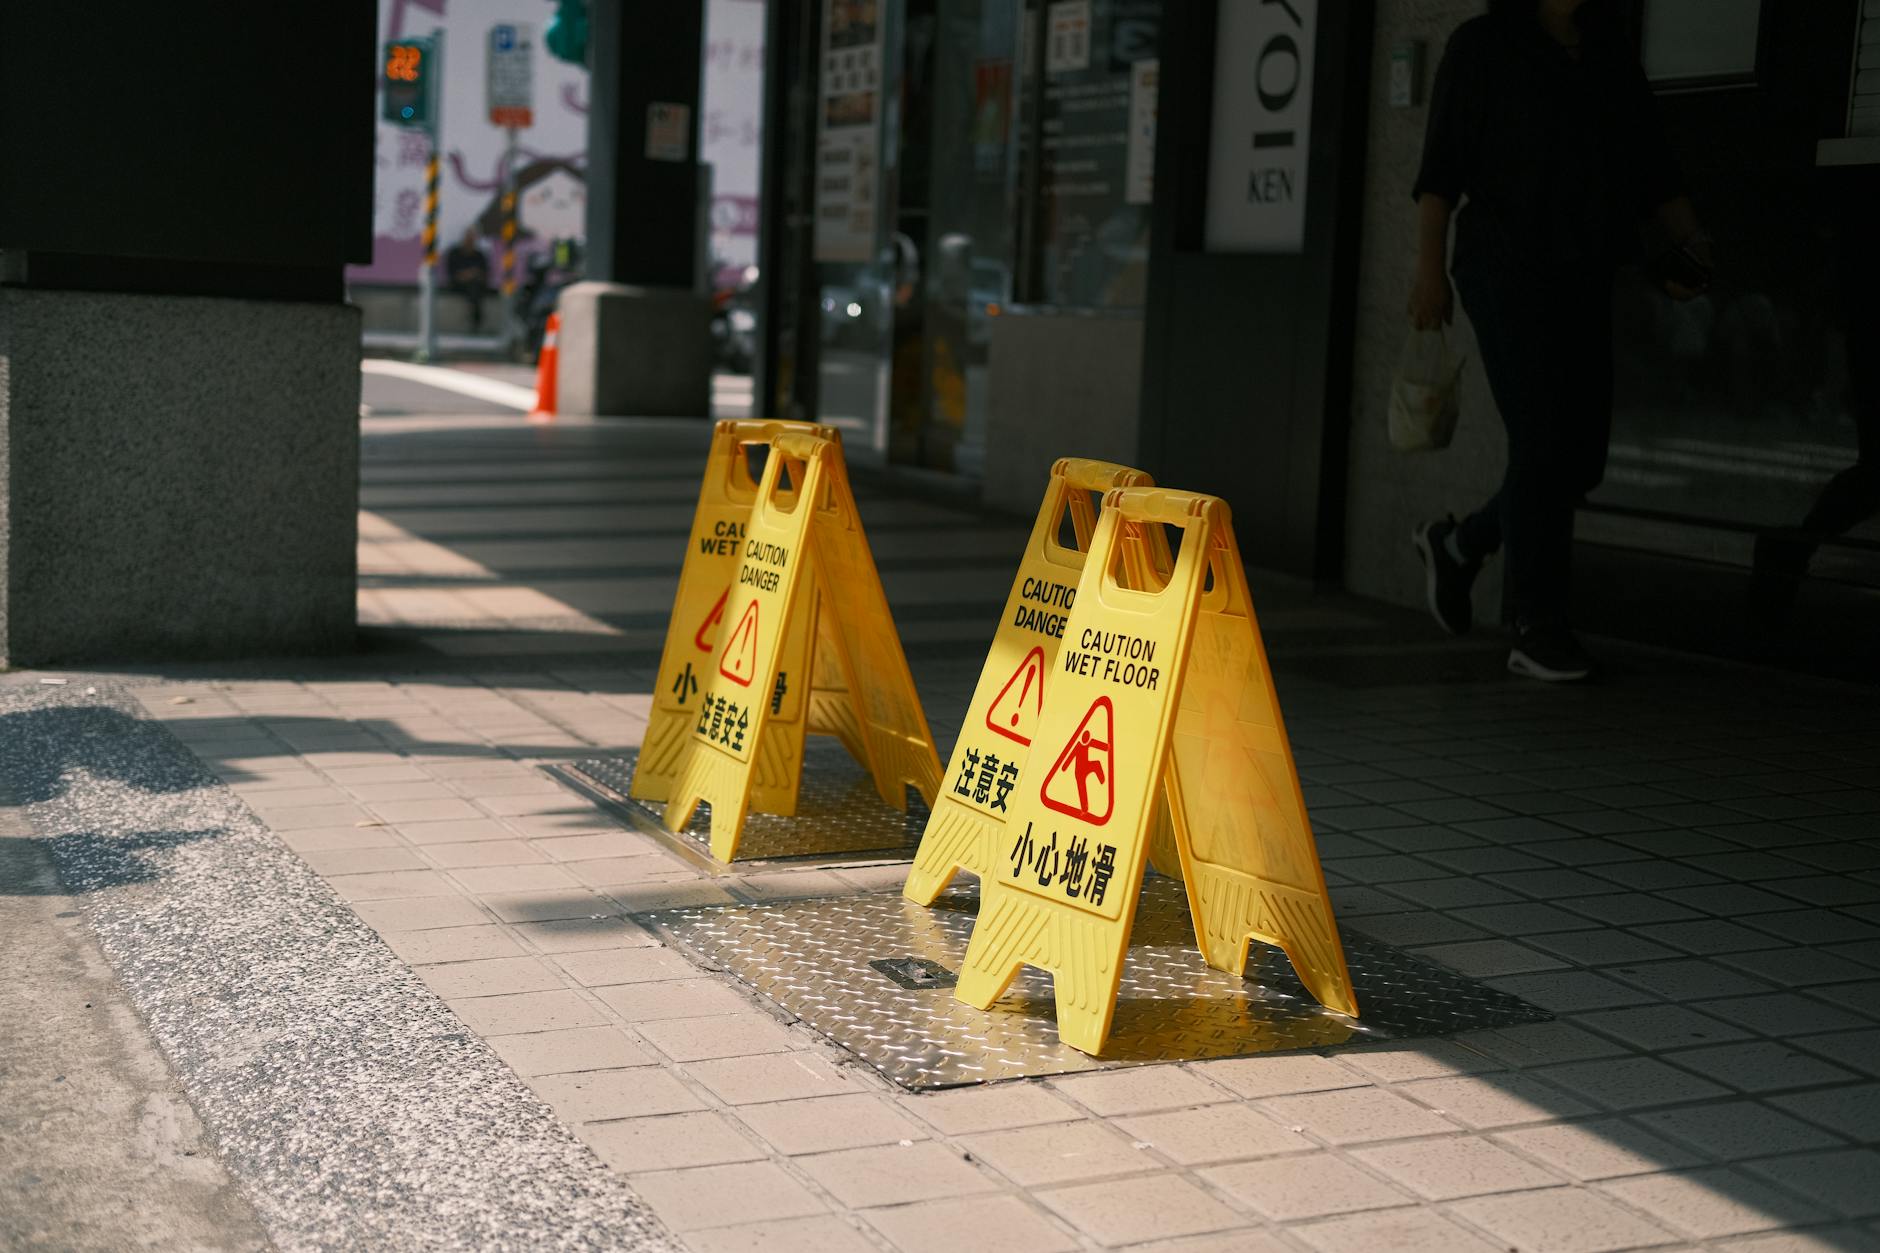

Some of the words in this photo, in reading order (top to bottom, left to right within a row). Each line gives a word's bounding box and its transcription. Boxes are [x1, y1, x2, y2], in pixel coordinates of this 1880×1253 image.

[1248, 168, 1296, 203] KEN
[701, 538, 740, 556] WET
[746, 539, 789, 567] CAUTION
[740, 564, 780, 593] DANGER
[1022, 577, 1077, 610] CAUTIO
[1014, 605, 1069, 639] DANGE
[1081, 628, 1156, 662] CAUTION
[1064, 651, 1102, 678] WET
[1103, 659, 1160, 690] FLOOR
[696, 691, 749, 752] 注意安全
[953, 747, 1020, 813] 注意安
[1010, 821, 1117, 907] 小心地滑
